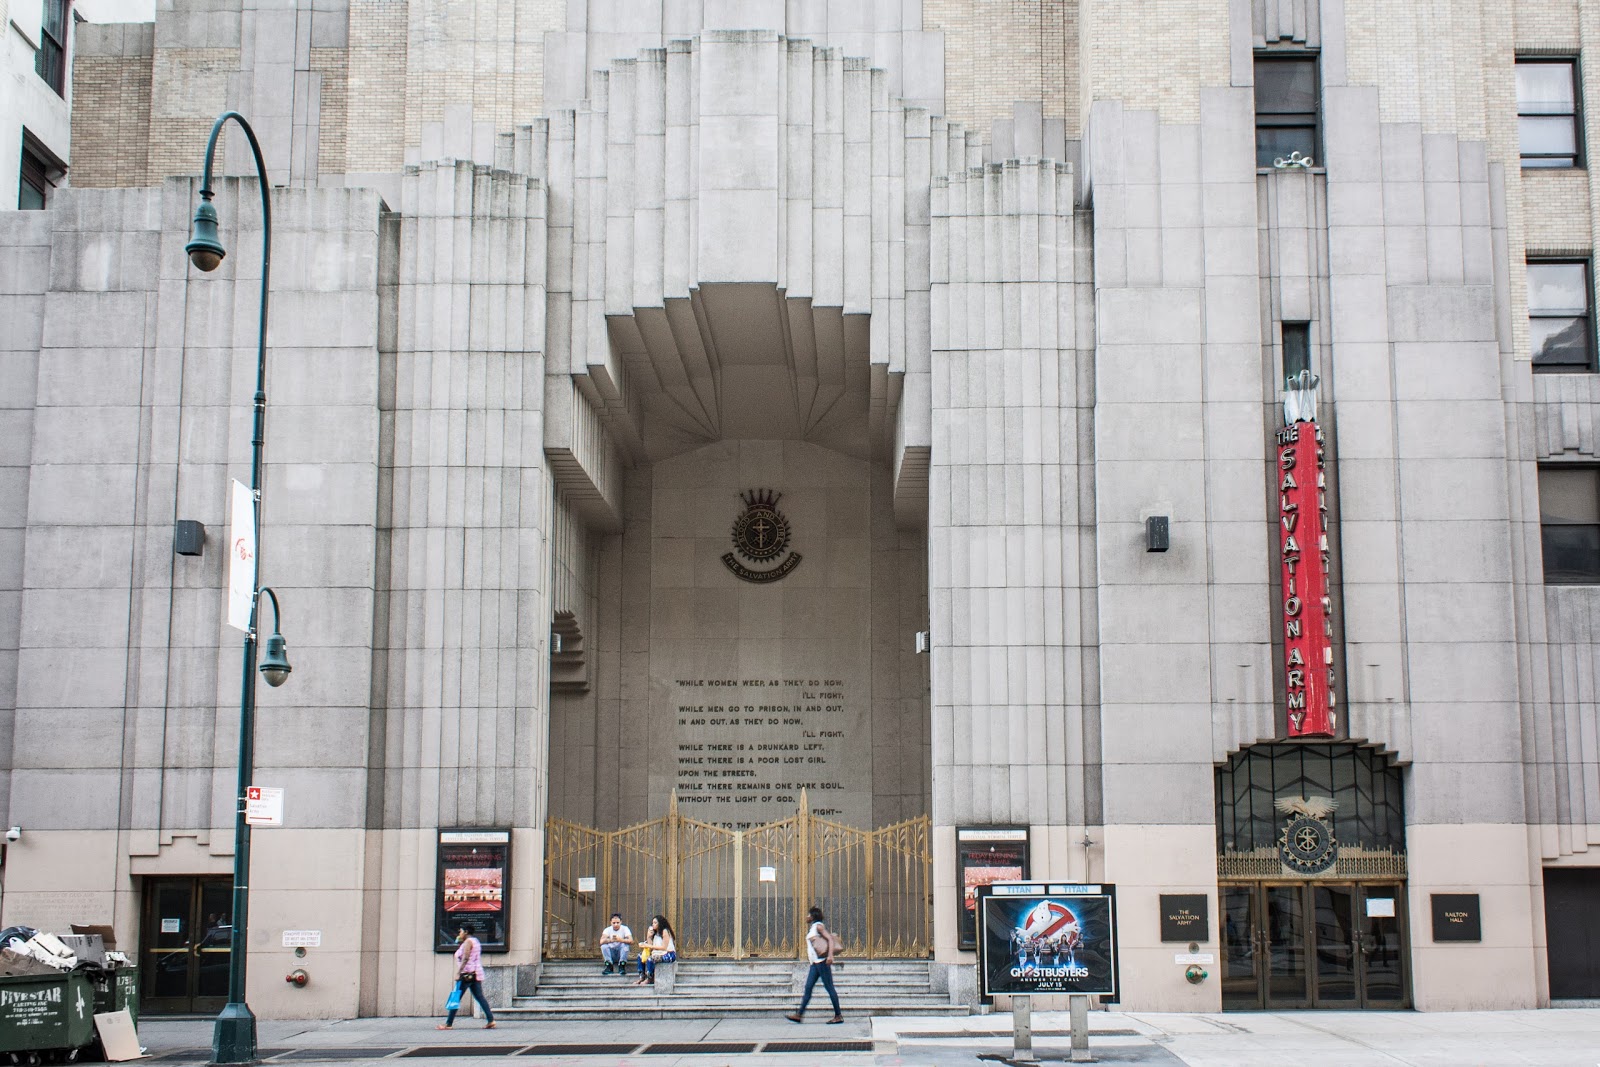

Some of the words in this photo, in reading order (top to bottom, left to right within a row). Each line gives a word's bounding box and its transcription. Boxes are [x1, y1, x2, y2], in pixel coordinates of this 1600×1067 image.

[1276, 424, 1299, 447] THE
[756, 511, 775, 520] AND
[1280, 447, 1303, 640] SALVATION
[725, 554, 739, 570] THE
[740, 568, 782, 580] SALVATION
[783, 553, 798, 570] ARMY
[1287, 647, 1306, 732] ARMY
[1010, 967, 1088, 977] GHOSTBUSTERS
[1, 990, 28, 1006] FIVE
[30, 987, 61, 1002] STAR
